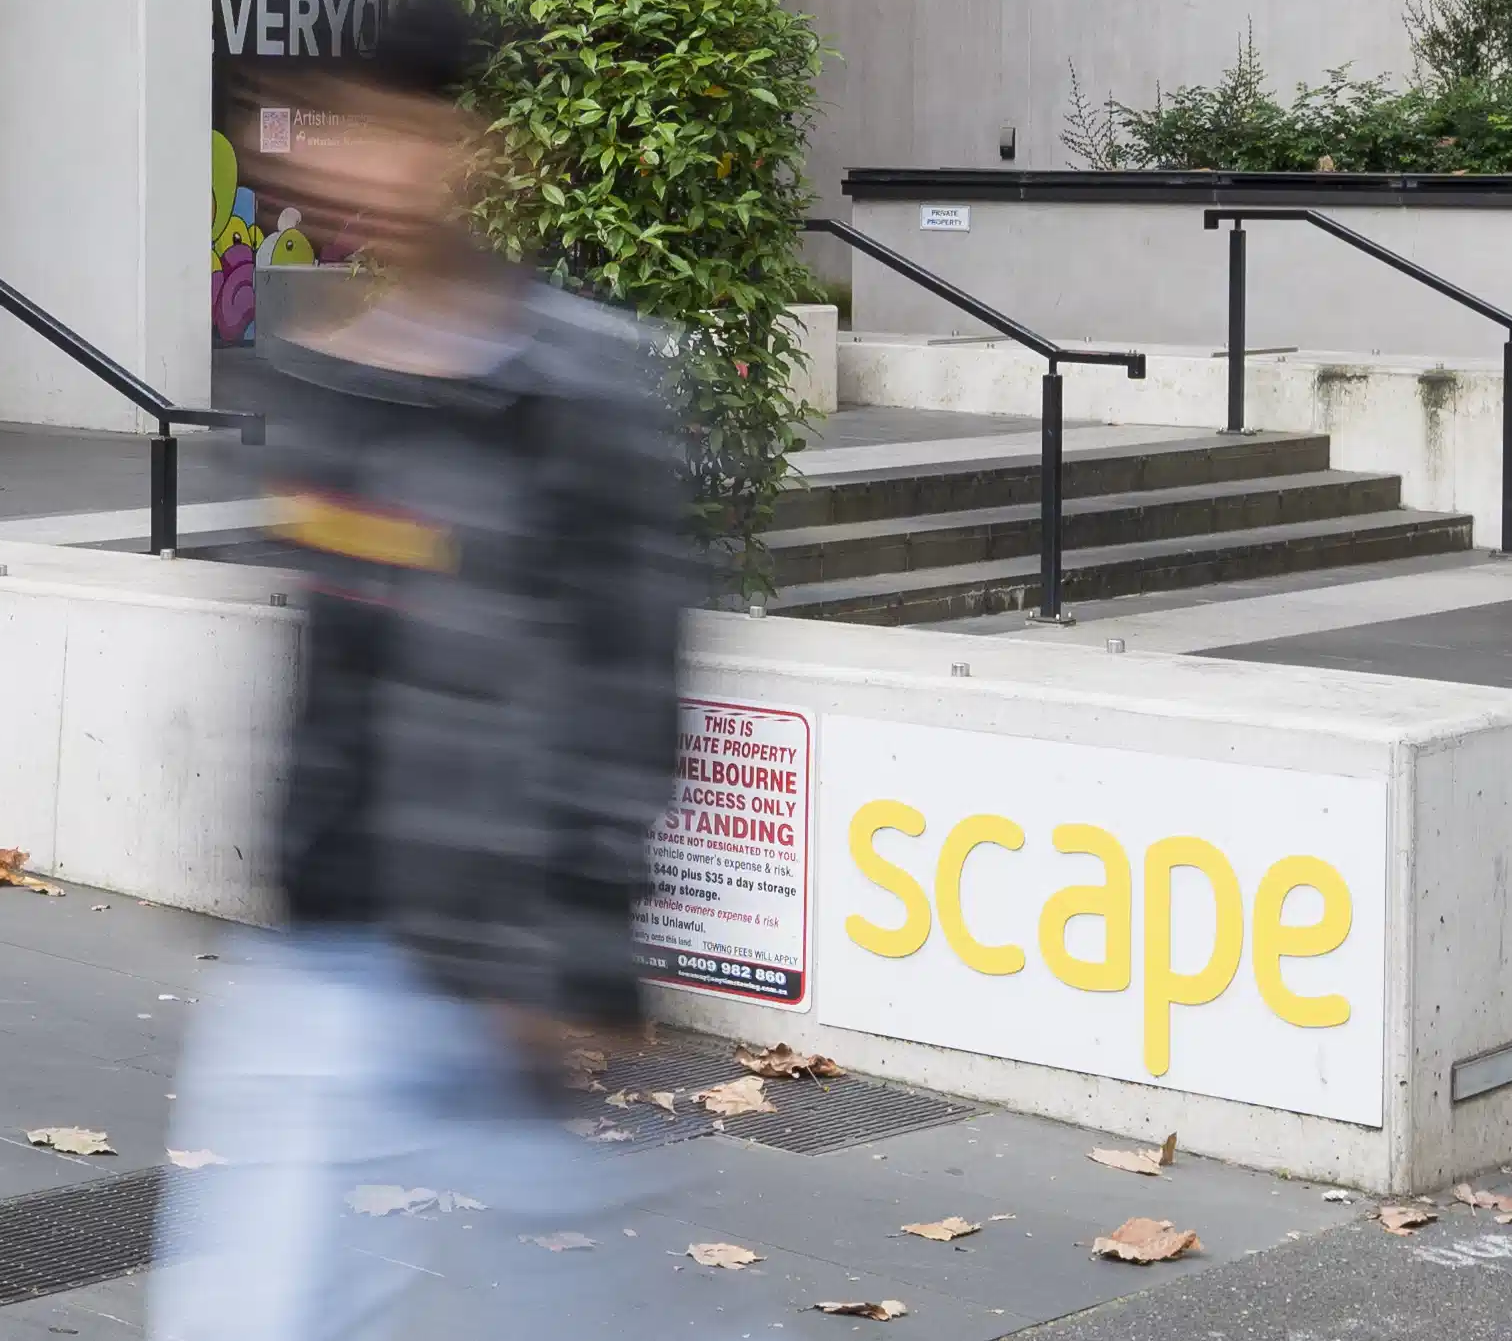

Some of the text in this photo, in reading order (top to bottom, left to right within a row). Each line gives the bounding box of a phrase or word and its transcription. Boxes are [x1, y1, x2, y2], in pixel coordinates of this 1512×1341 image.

[705, 715, 753, 737] THIS IS
[679, 732, 797, 764] IVATE PROPERTY
[682, 785, 746, 811] ACCESS
[751, 796, 796, 817] ONLY
[665, 807, 794, 846] STANDING
[653, 845, 684, 860] vehicle
[687, 852, 722, 866] owner's
[724, 858, 762, 873] expense
[658, 832, 684, 845] SPACE
[687, 836, 703, 847] NOT
[707, 839, 761, 856] DESIGNATED
[764, 848, 775, 858] TO
[658, 881, 677, 896] day
[679, 884, 721, 901] storage.
[681, 867, 702, 881] plus
[705, 871, 724, 885] $35
[727, 877, 733, 886] a
[736, 878, 754, 892] day
[757, 882, 797, 897] storage
[654, 898, 683, 912] vehicle
[684, 904, 715, 917] owners
[717, 909, 752, 923] expense
[763, 917, 780, 929] risk
[845, 798, 1352, 1076] scape
[677, 954, 717, 973] 0409
[721, 962, 753, 979] 982
[755, 968, 787, 985] 860
[734, 946, 753, 957] FEES
[774, 954, 798, 966] APPLY
